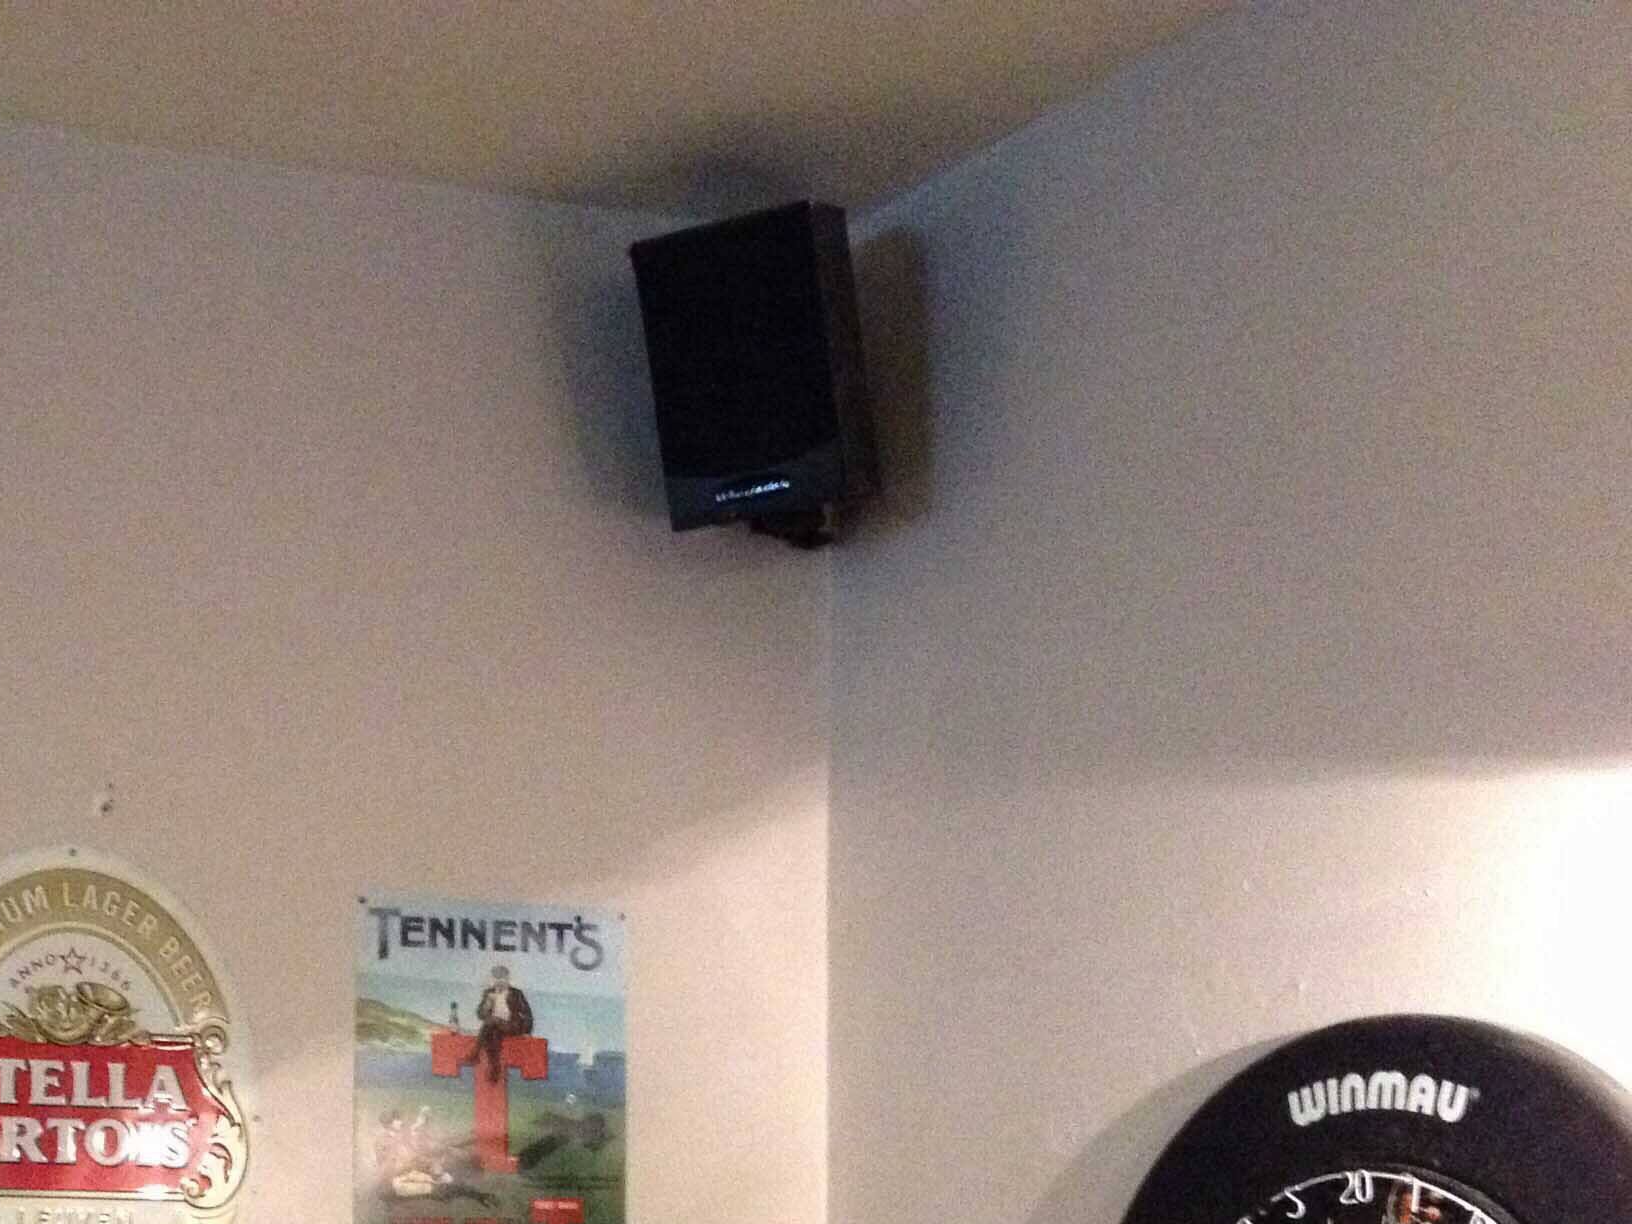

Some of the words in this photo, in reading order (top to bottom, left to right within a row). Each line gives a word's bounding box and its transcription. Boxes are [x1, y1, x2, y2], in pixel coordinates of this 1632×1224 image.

[62, 881, 158, 940] LAGER
[369, 906, 605, 972] TENNENT'S
[9, 952, 56, 987] ANNO
[1339, 1169, 1374, 1204] 20
